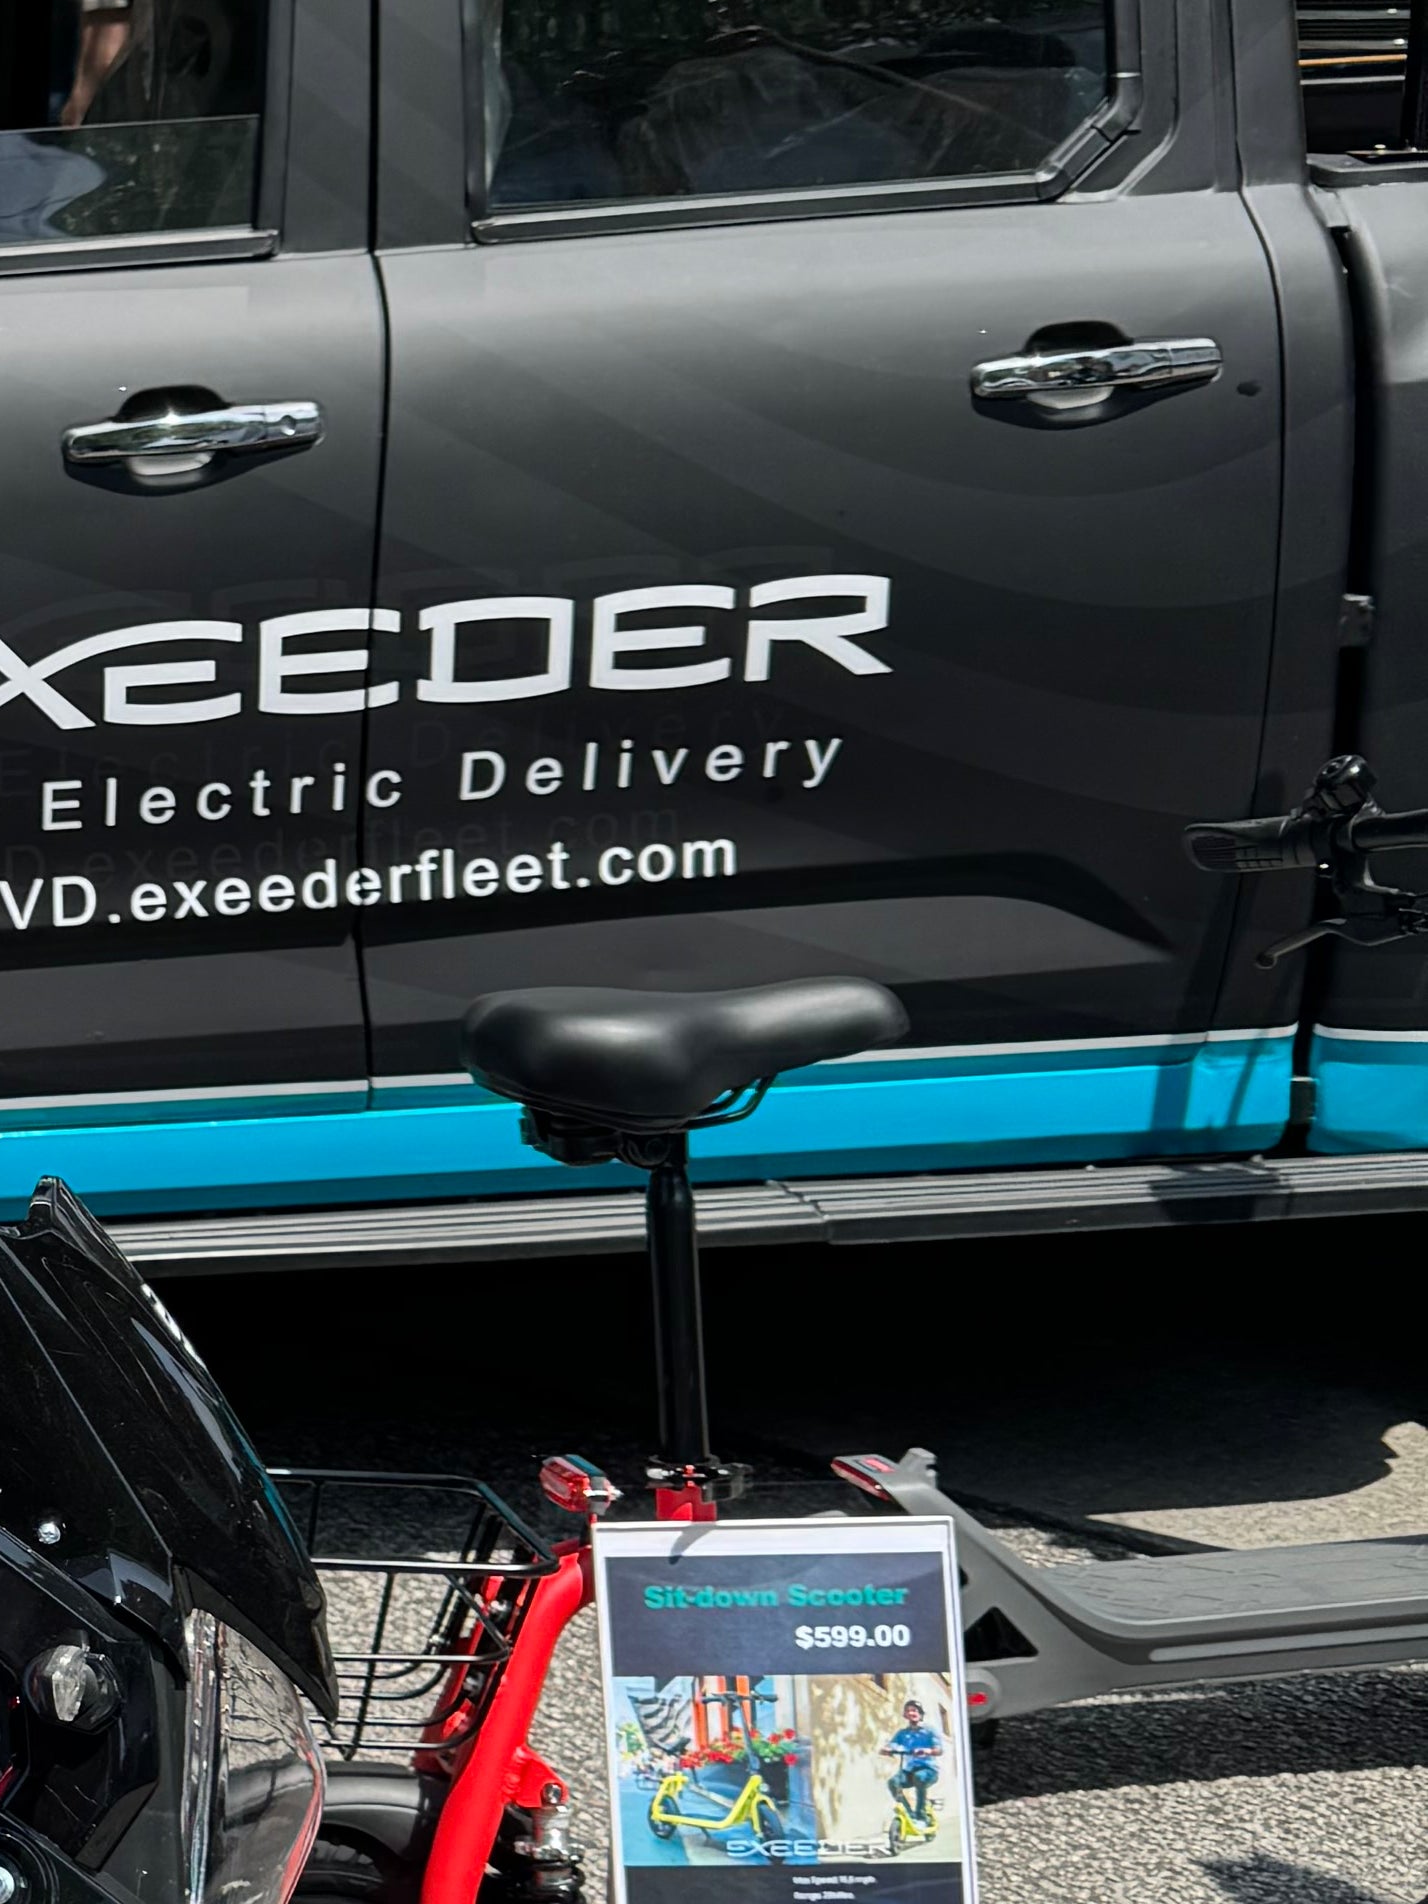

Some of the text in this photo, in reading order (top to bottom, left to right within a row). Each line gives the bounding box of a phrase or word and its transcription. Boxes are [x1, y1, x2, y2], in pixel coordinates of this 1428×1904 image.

[41, 762, 403, 830] Electric
[459, 736, 843, 801] Delivery
[644, 1583, 909, 1609] Sit-down Scooter
[795, 1624, 911, 1649] $599.00
